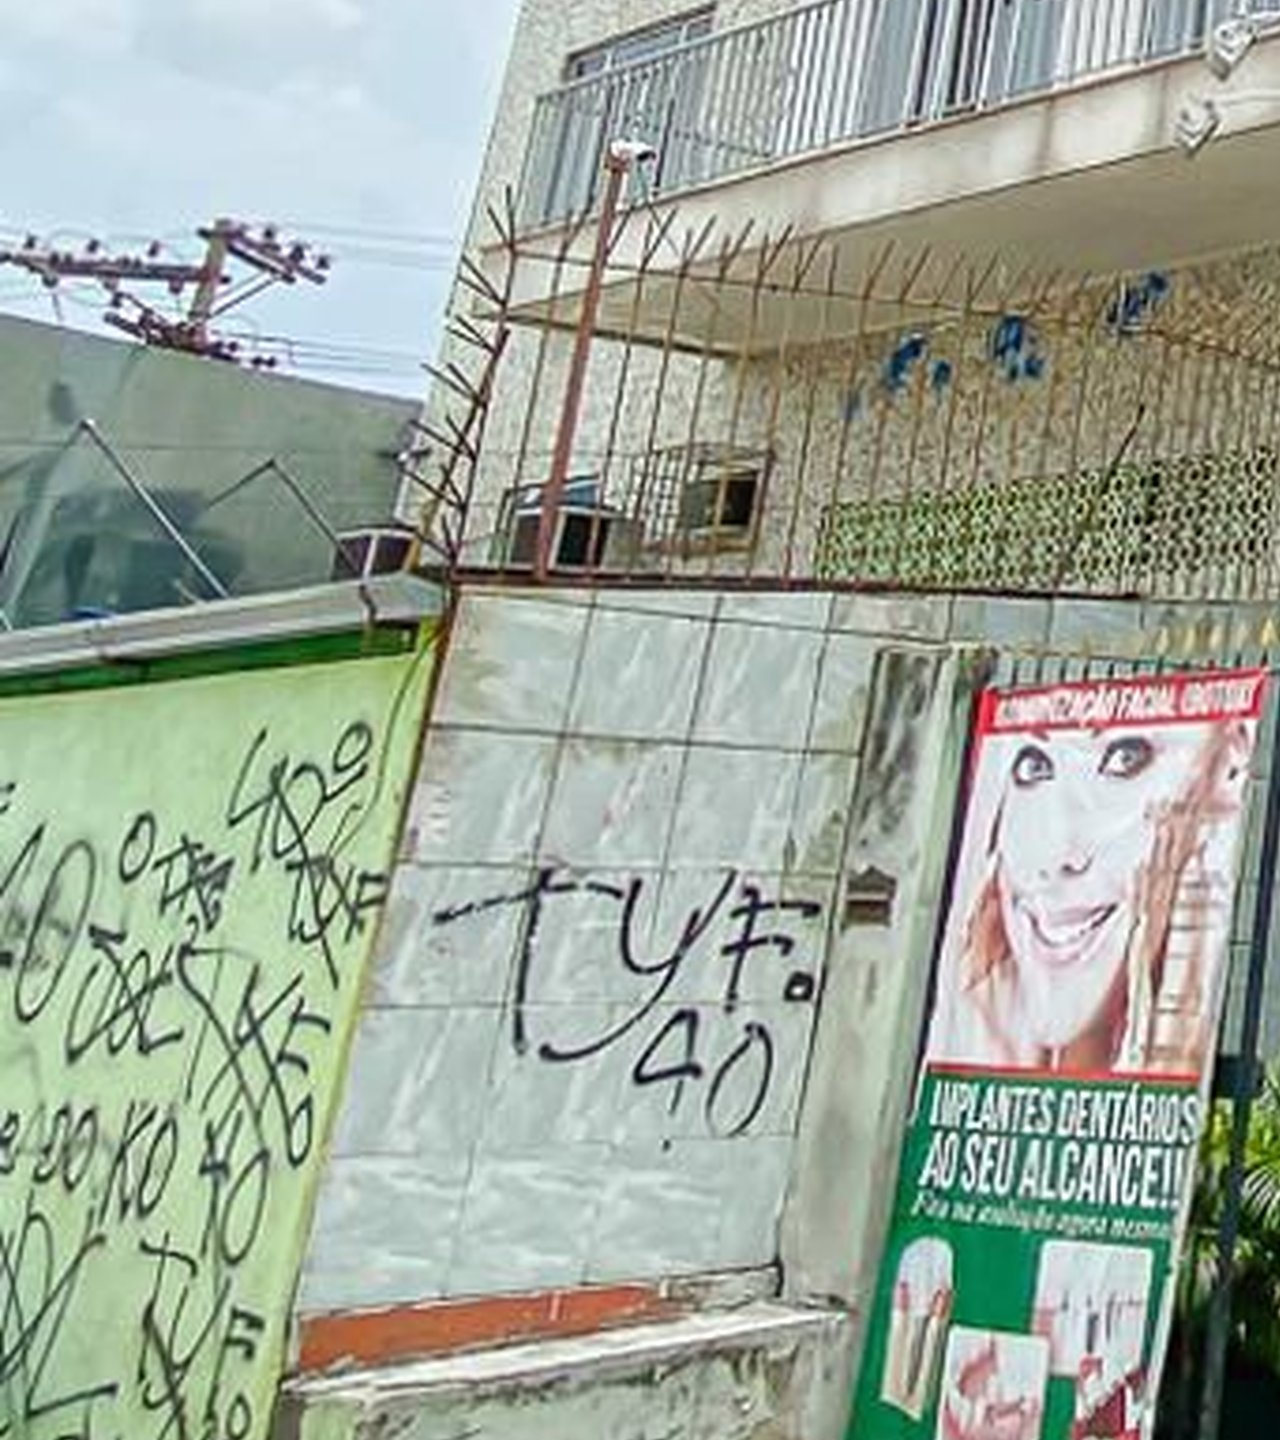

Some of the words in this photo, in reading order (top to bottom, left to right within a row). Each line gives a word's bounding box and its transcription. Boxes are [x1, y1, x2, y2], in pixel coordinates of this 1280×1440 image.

[929, 1080, 1053, 1133] IMPLANTES
[1055, 1083, 1199, 1144] DENTÁRIOS
[918, 1131, 961, 1189] AO
[961, 1135, 1017, 1197] SEU
[1018, 1139, 1186, 1207] ALCANCE!!
